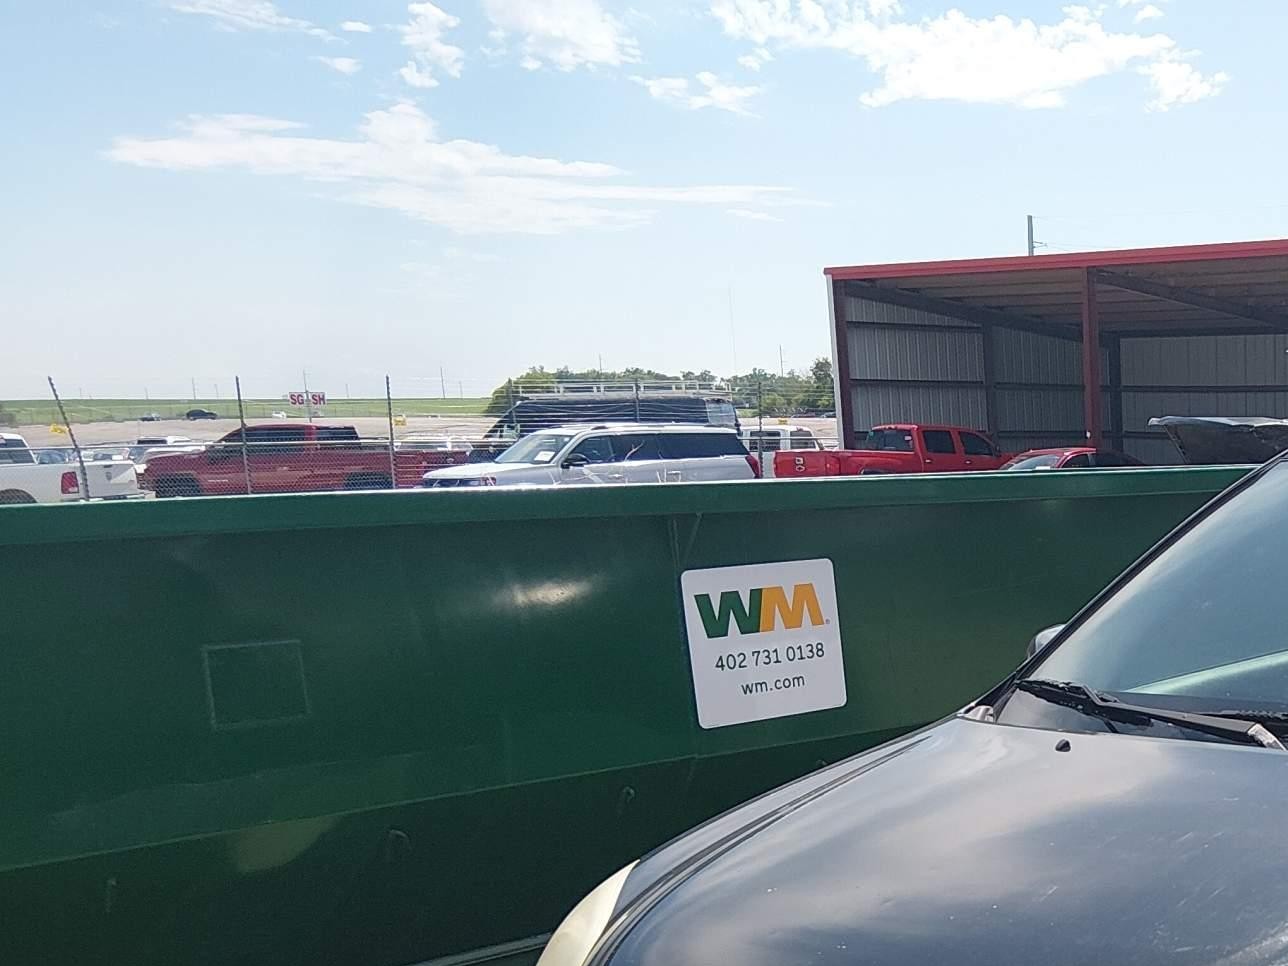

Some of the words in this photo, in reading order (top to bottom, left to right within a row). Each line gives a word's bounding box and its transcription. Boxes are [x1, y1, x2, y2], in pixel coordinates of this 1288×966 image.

[290, 393, 305, 405] SG
[311, 393, 326, 406] SH
[694, 583, 825, 639] WM
[715, 652, 747, 671] 402
[752, 648, 782, 667] 731
[786, 642, 825, 661] 0138
[741, 675, 805, 695] wm.com
